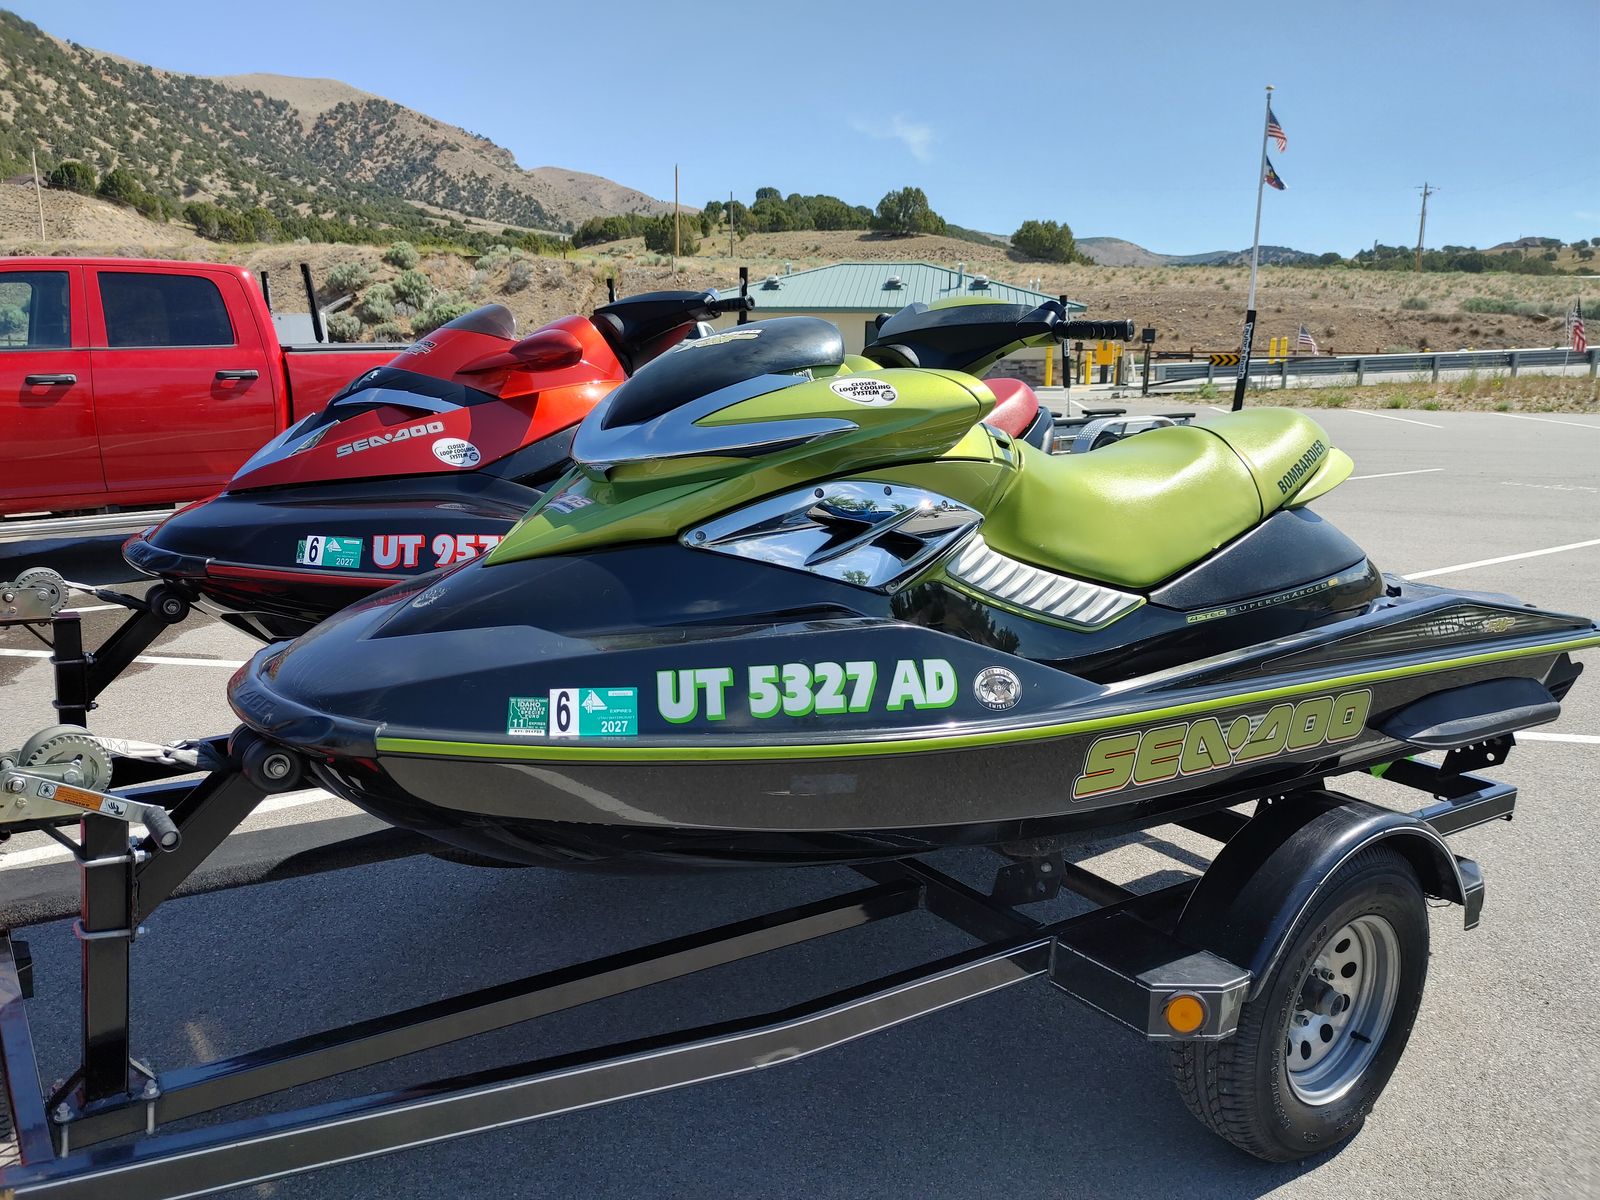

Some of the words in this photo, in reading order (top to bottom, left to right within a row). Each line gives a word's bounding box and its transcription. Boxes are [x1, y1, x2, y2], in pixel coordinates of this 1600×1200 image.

[1242, 322, 1253, 355] Taylor's
[1238, 355, 1248, 379] Boats
[1277, 440, 1326, 495] BOMBARDIER
[309, 537, 319, 562] 6
[336, 557, 354, 566] 2027
[373, 534, 425, 569] UT
[432, 534, 505, 568] 957
[1230, 583, 1327, 614] SUPERCHARGED
[656, 667, 734, 724] UT
[747, 662, 878, 719] 5327
[885, 658, 958, 711] AD
[556, 691, 570, 732] 6
[601, 720, 628, 733] 2027
